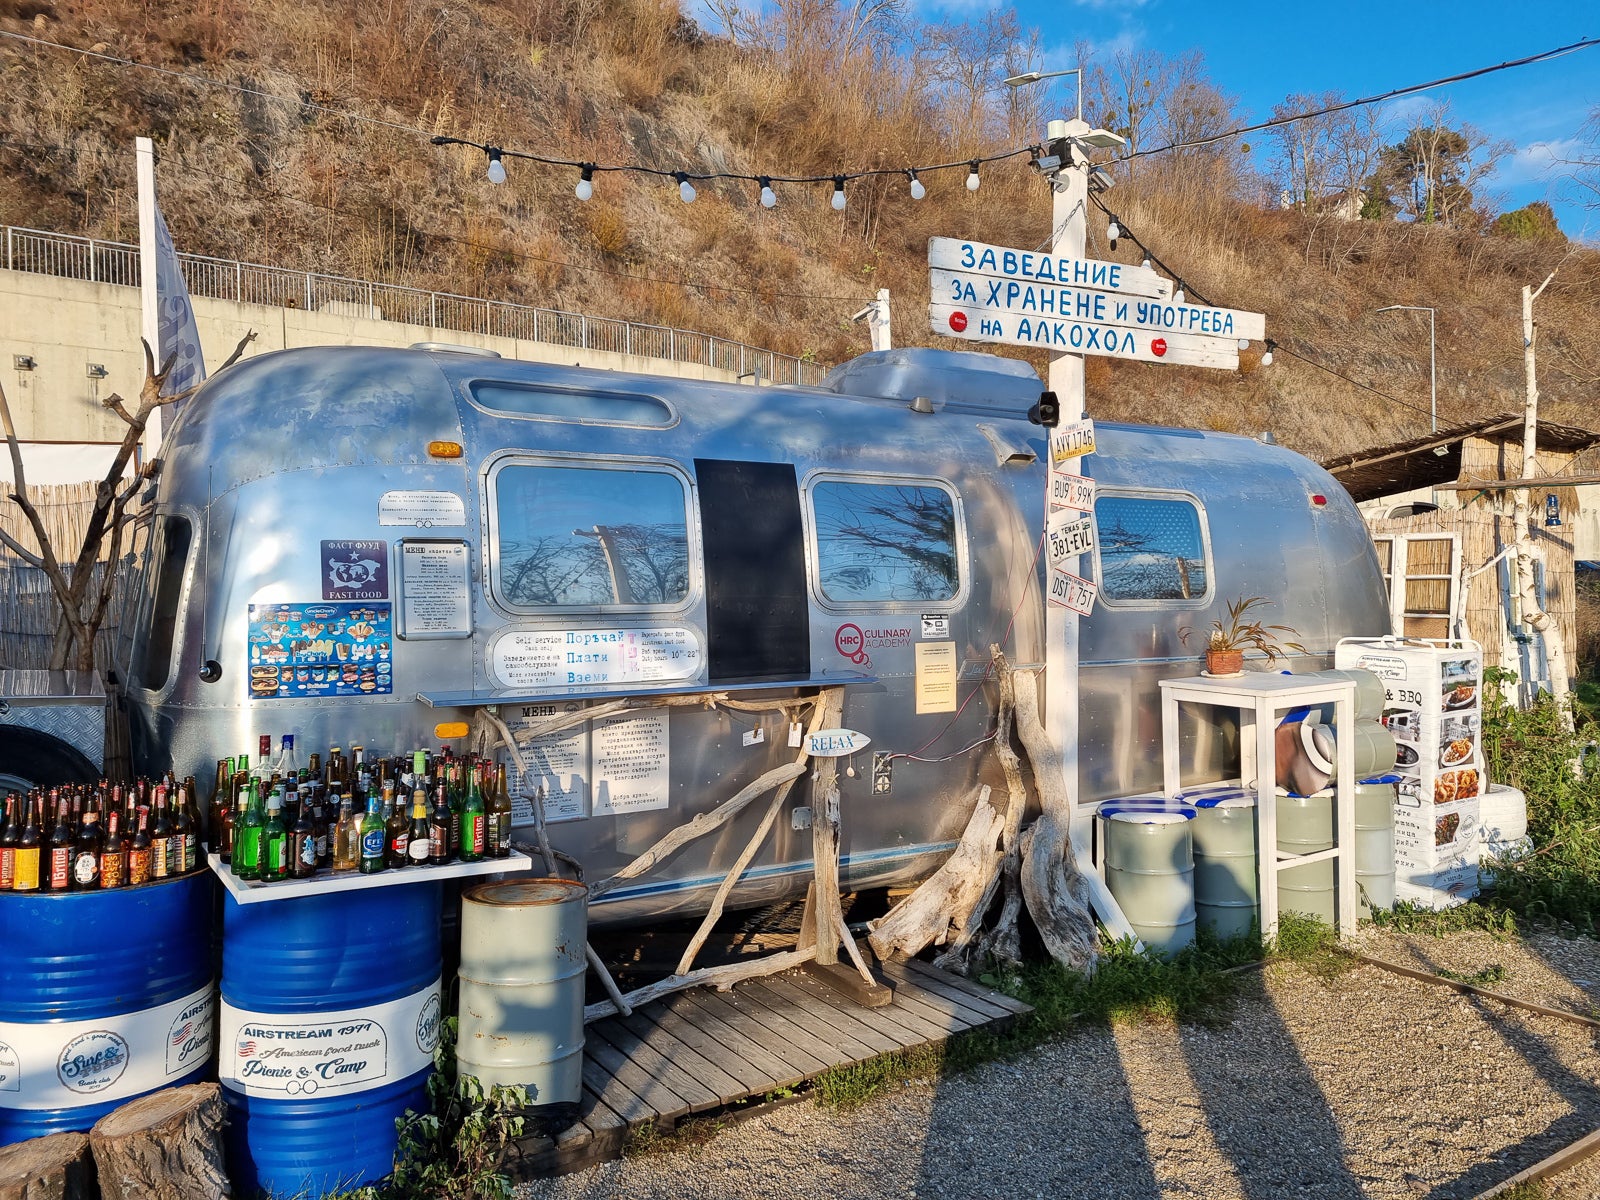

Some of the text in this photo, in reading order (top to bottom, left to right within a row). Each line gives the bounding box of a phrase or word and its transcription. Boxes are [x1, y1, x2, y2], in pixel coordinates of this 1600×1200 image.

[960, 244, 1122, 288] ЗАВЕДЕНИЕ
[951, 279, 976, 302] ЗА
[986, 280, 1107, 320] ХРАНЕНЕ
[1136, 302, 1235, 335] УПОТРЕБА
[1017, 318, 1136, 354] АЛКОХОЛ
[1072, 429, 1093, 450] 1746
[1054, 480, 1093, 505] BU9 99K
[1061, 523, 1080, 534] TEXAS
[355, 542, 380, 550] ФУУД
[329, 591, 382, 599] FAST FOOD
[1052, 576, 1094, 608] DST 75T
[566, 630, 624, 646] Поръчай
[839, 636, 860, 645] HRC
[864, 628, 912, 639] CULINARY
[864, 638, 912, 649] ACADEMY
[566, 652, 608, 664] Плати
[567, 672, 608, 683] Вземи
[1385, 689, 1422, 706] & BBQ
[522, 705, 556, 717] МЕНЮ
[811, 734, 854, 752] RELAX
[474, 816, 482, 846] Britos
[54, 849, 66, 880] Britos
[244, 1027, 333, 1040] AIRSTREAM
[259, 1039, 381, 1060] American food truck
[61, 1046, 120, 1078] Surf &
[242, 1060, 293, 1078] Picnic
[315, 1058, 368, 1080] Camp
